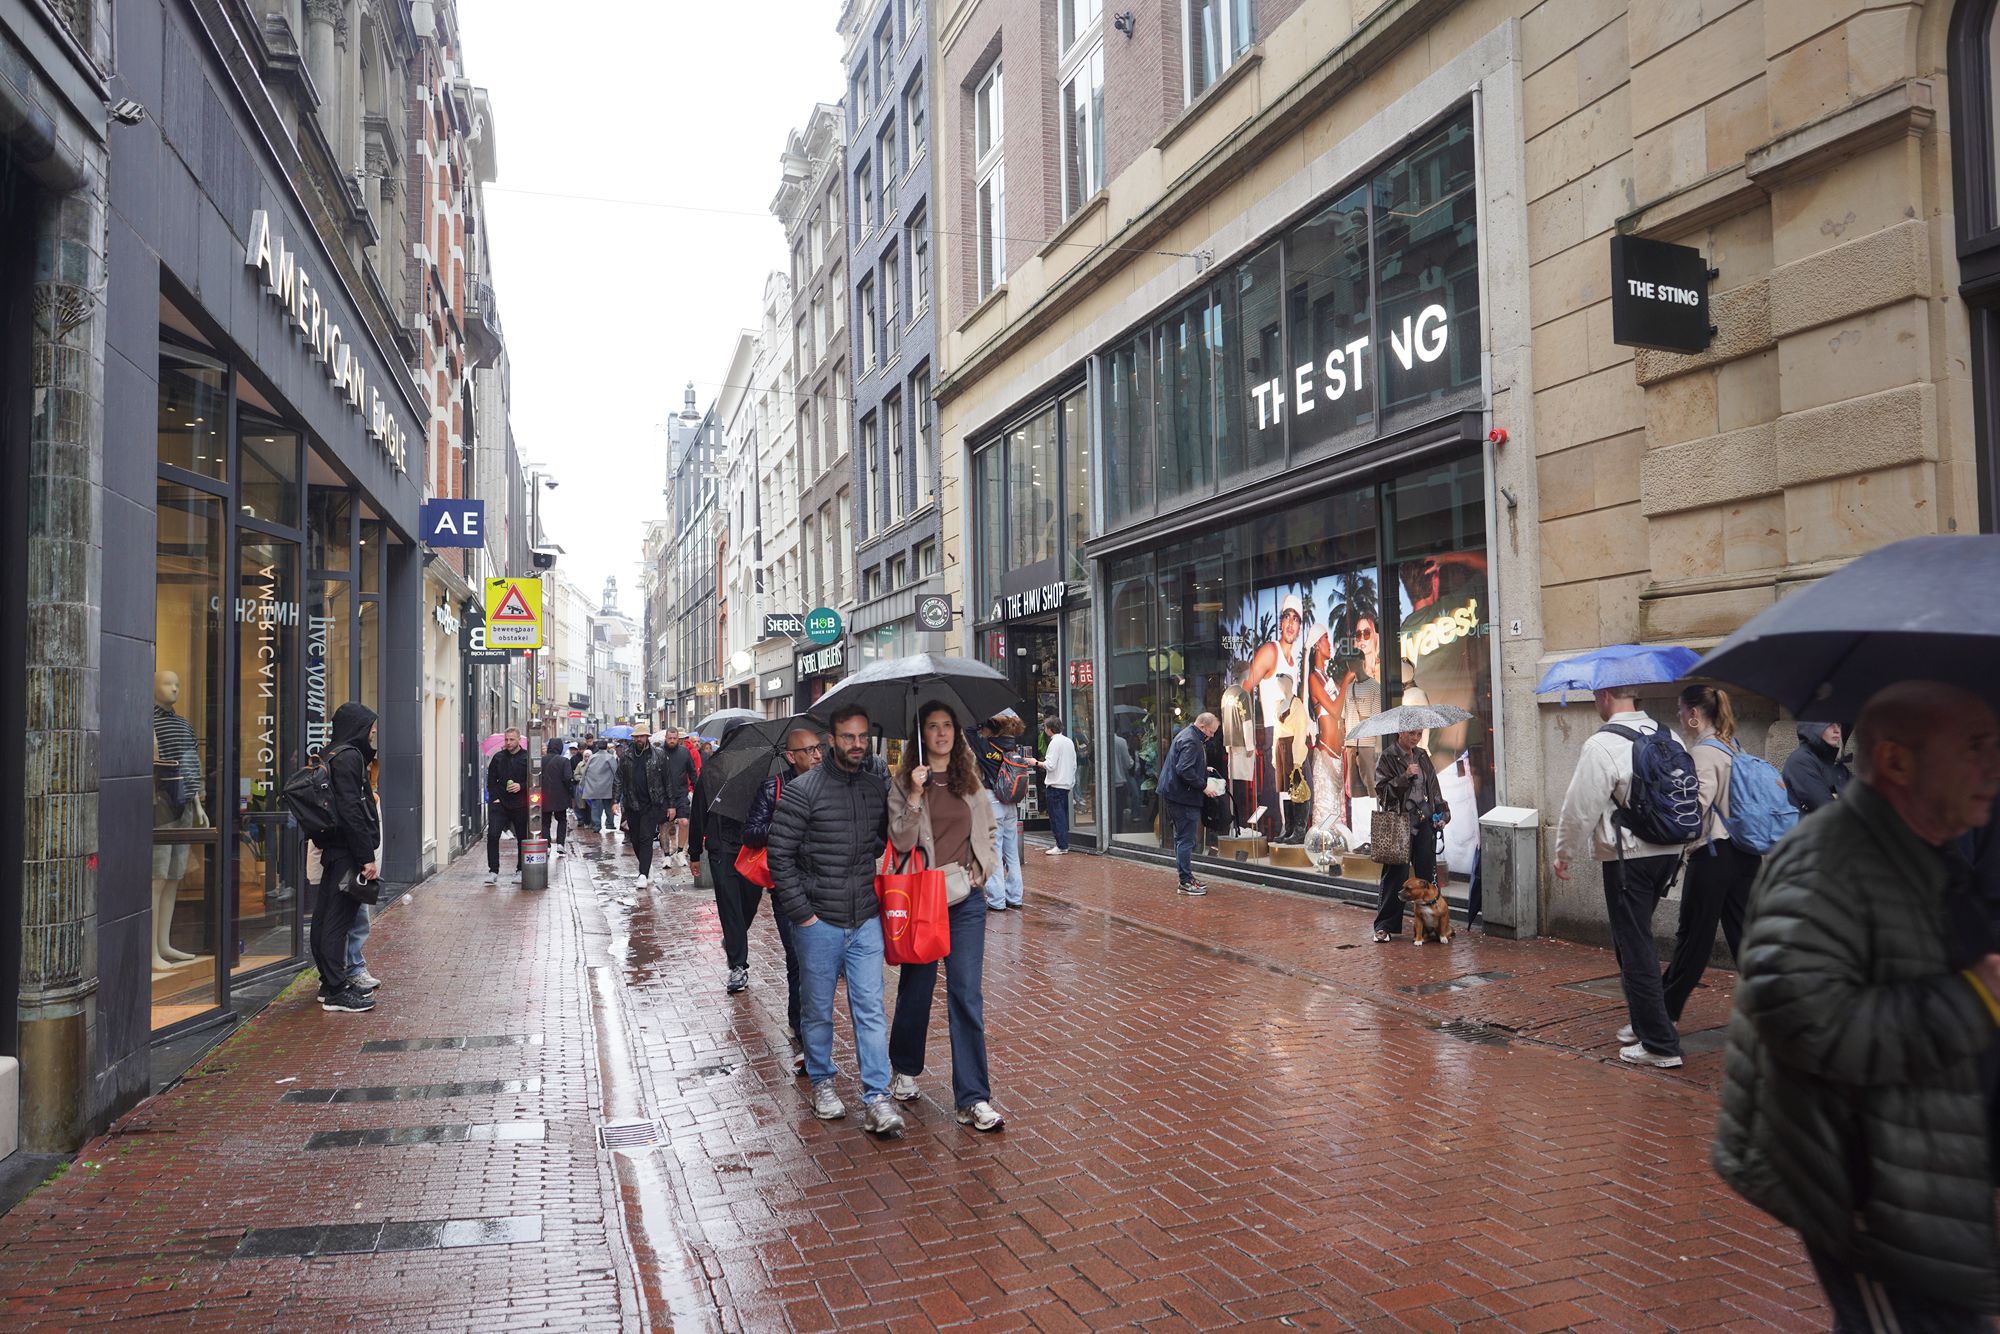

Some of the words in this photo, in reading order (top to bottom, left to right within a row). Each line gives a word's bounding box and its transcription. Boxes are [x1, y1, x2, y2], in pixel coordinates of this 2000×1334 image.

[1627, 279, 1655, 299] THE
[1657, 285, 1699, 307] STING
[251, 209, 365, 416] AMERICAN
[369, 385, 406, 474] EAGLE
[1252, 361, 1315, 431] THE
[1324, 304, 1448, 402] STNG
[434, 511, 479, 535] AE
[1007, 593, 1022, 620] THE
[1023, 588, 1041, 616] HMV
[1042, 581, 1065, 611] SHOP
[308, 614, 336, 657] live
[767, 619, 802, 632] SIEBEL
[810, 617, 836, 629] H&B
[1512, 622, 1519, 634] 4
[802, 652, 818, 675] SIEBEL
[305, 662, 327, 717] your
